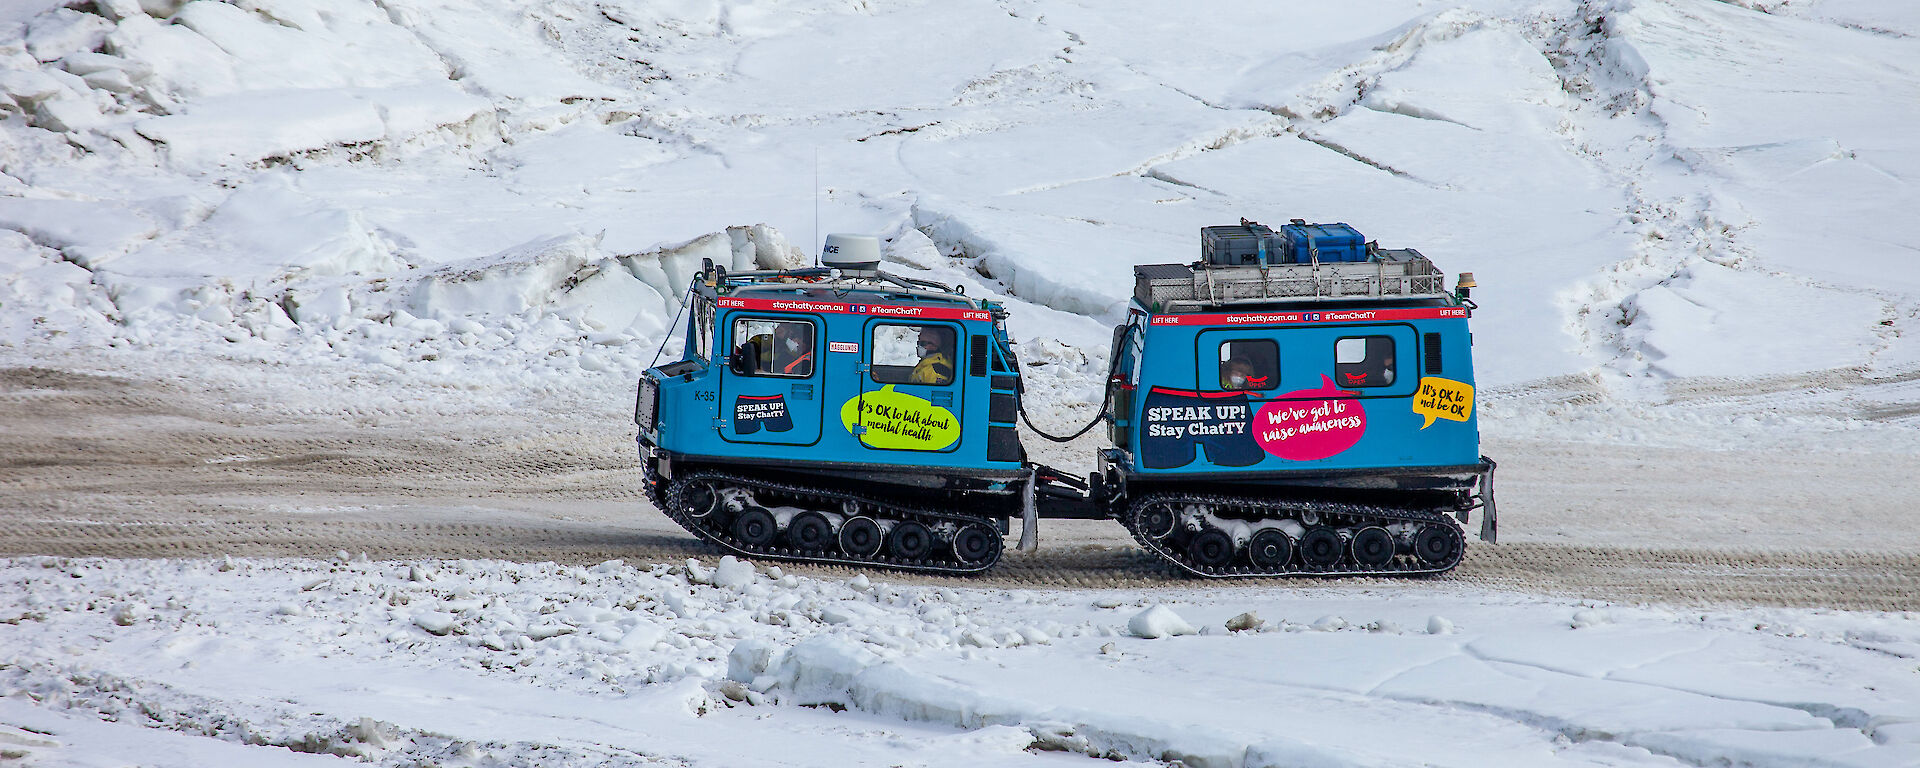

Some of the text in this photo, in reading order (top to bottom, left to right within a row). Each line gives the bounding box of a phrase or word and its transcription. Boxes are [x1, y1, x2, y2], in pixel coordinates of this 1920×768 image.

[772, 301, 844, 311] staychatty.com.au
[871, 306, 922, 315] #TeamChatTY
[975, 312, 989, 320] HERE
[1163, 316, 1179, 324] HERE
[1226, 314, 1298, 324] staychatty.com.au
[1325, 311, 1376, 320] #TeamChatTY
[694, 390, 715, 401] K-35
[1422, 384, 1464, 402] It's OK to
[737, 402, 784, 413] SPEAK UP!
[1148, 405, 1246, 421] SPEAK UP!
[1267, 399, 1347, 424] We've got to
[1420, 398, 1465, 418] not be OK
[737, 410, 784, 421] Stay ChatTY
[875, 404, 891, 419] OK
[892, 407, 903, 420] to
[903, 409, 921, 427] talk
[921, 413, 950, 430] about
[867, 420, 933, 442] mental health
[1149, 421, 1246, 439] Stay ChatTY
[1262, 415, 1361, 442] raise awareness
